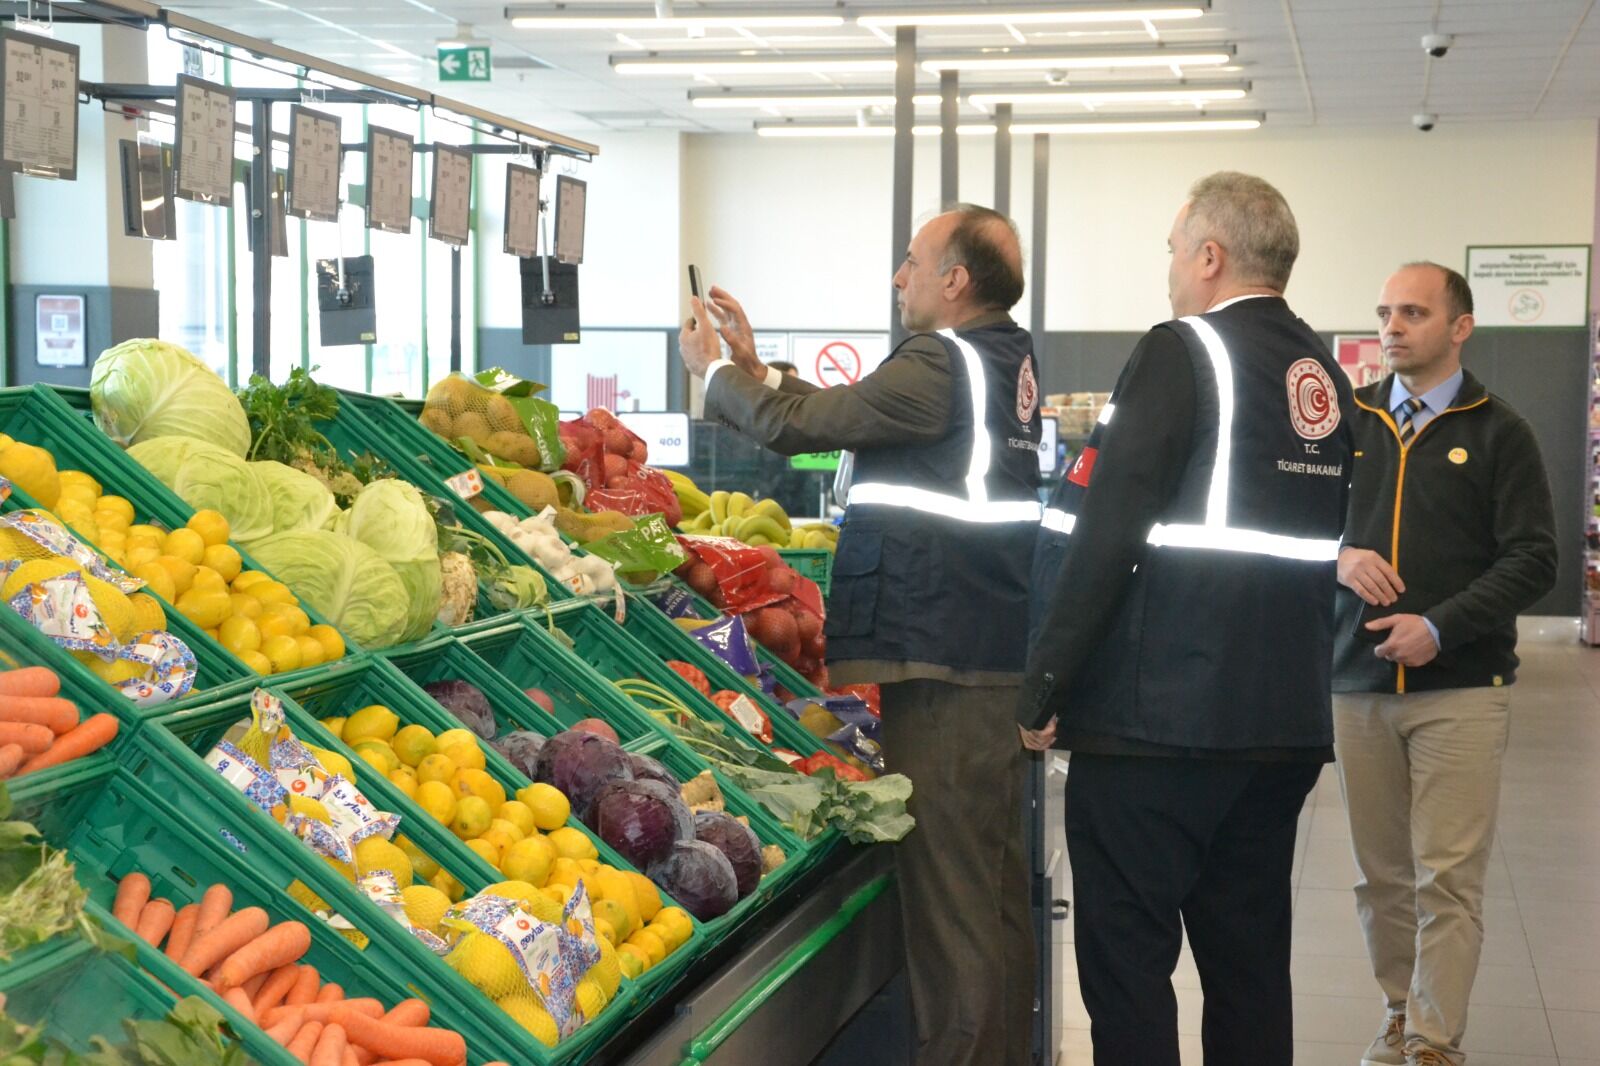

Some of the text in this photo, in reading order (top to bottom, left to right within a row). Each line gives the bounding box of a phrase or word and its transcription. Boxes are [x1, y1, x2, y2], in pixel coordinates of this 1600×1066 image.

[659, 437, 682, 447] 400
[1304, 443, 1321, 455] T.C.
[1277, 458, 1306, 474] TİCARET
